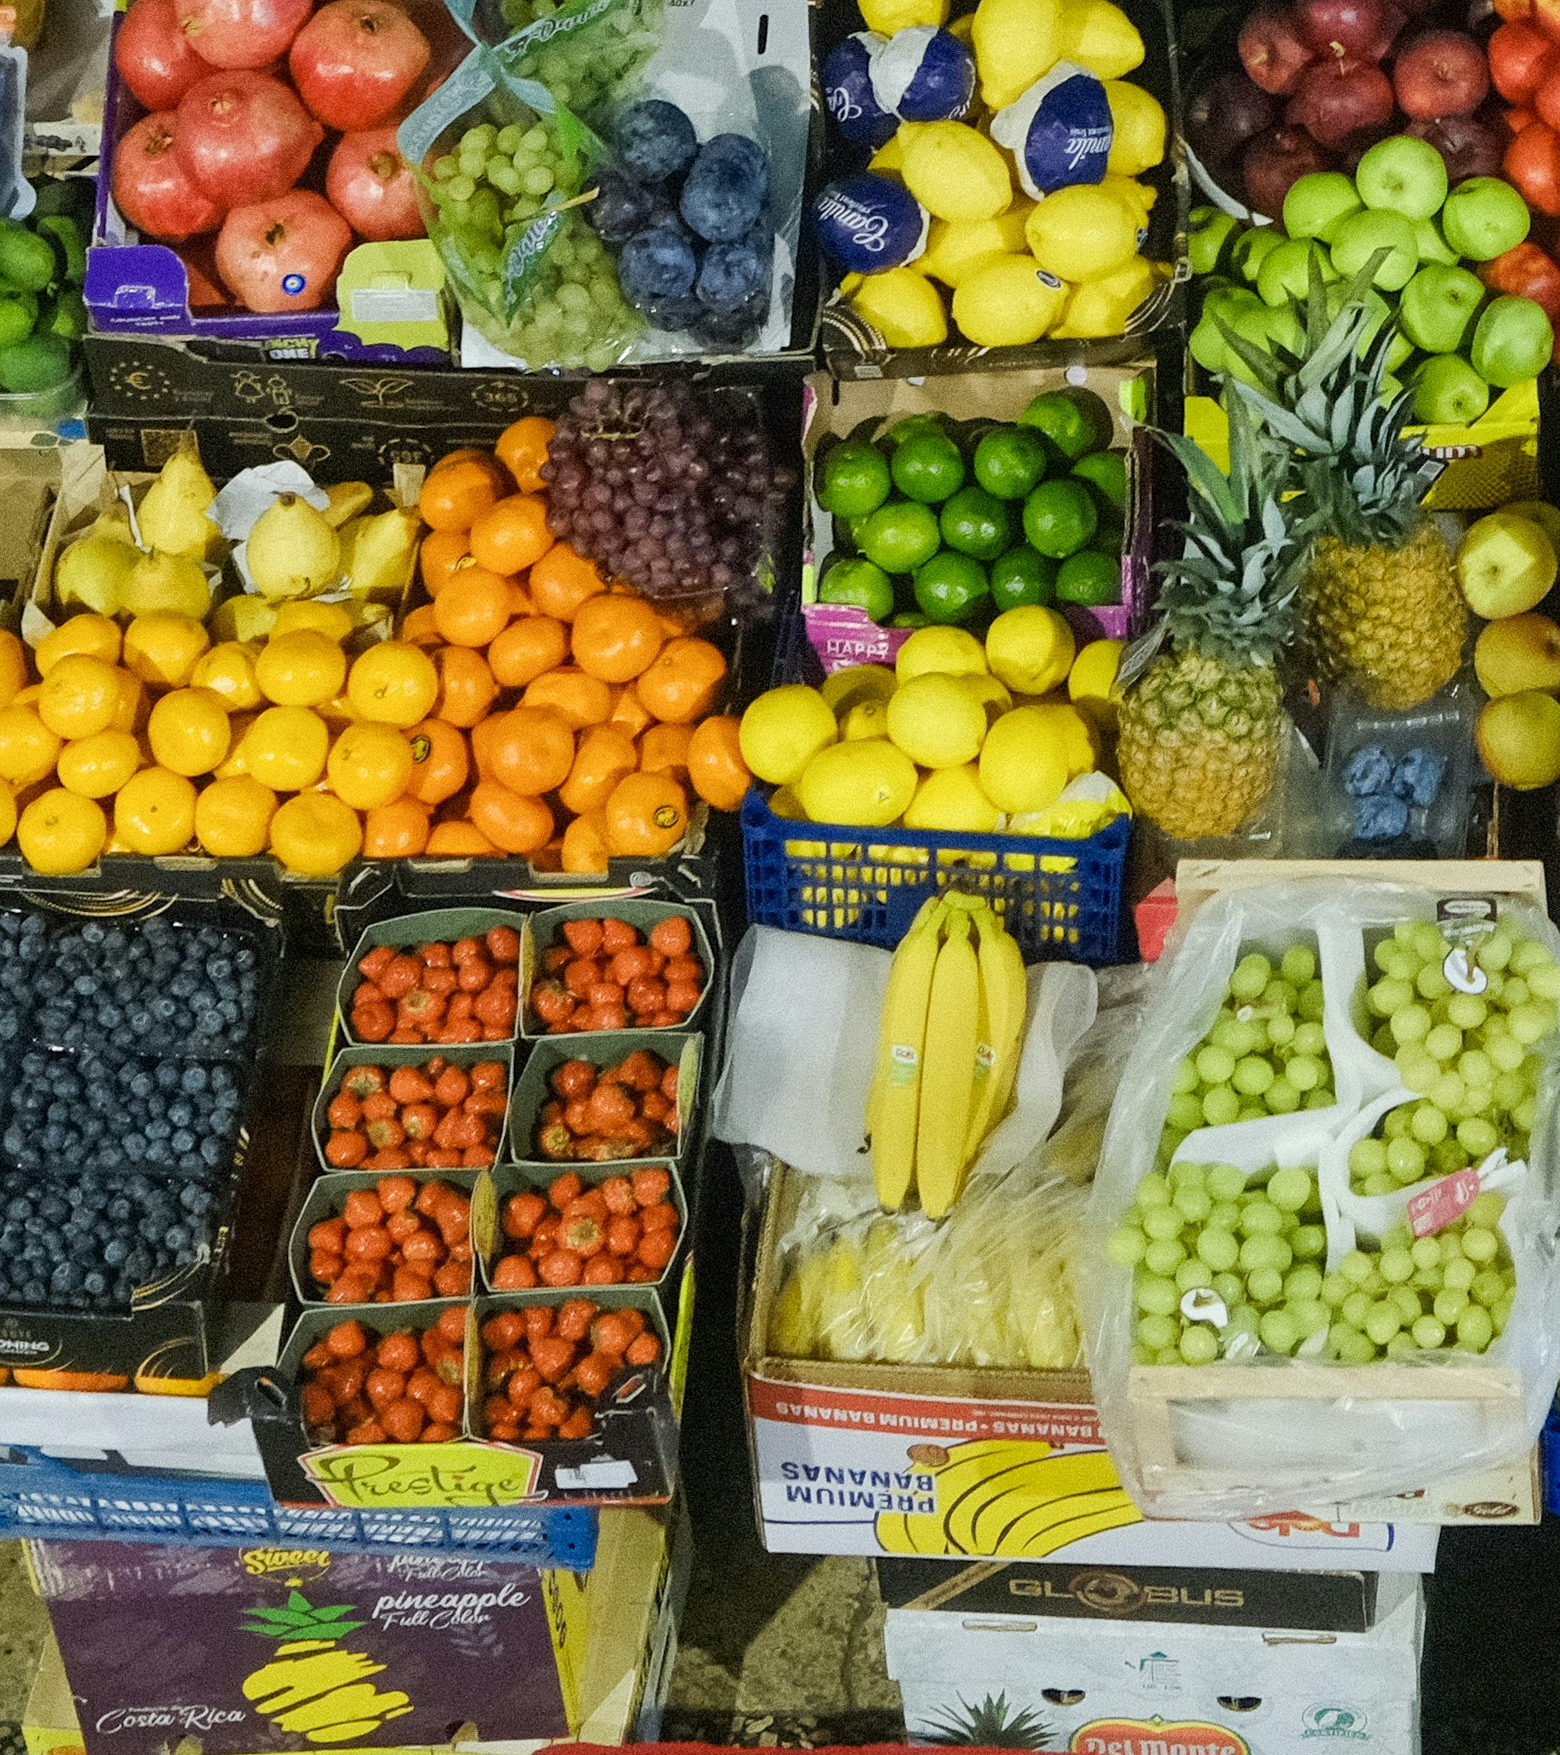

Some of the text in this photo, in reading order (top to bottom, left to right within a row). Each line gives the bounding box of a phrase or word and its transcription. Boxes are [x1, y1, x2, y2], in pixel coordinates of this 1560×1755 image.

[817, 196, 889, 252] Camila
[827, 639, 889, 657] HAPPY
[776, 1402, 1095, 1440] BANANAS PREMIUM BANANAS
[313, 1453, 547, 1508] Prestige
[780, 1460, 935, 1493] BANANAS
[786, 1484, 935, 1514] PREMIUM
[371, 1583, 531, 1619] pineapple
[1009, 1573, 1245, 1612] GLOBUS
[379, 1605, 492, 1630] Full Color
[94, 1703, 247, 1733] Costa Rica
[1085, 1737, 1238, 1755] Del Monte
